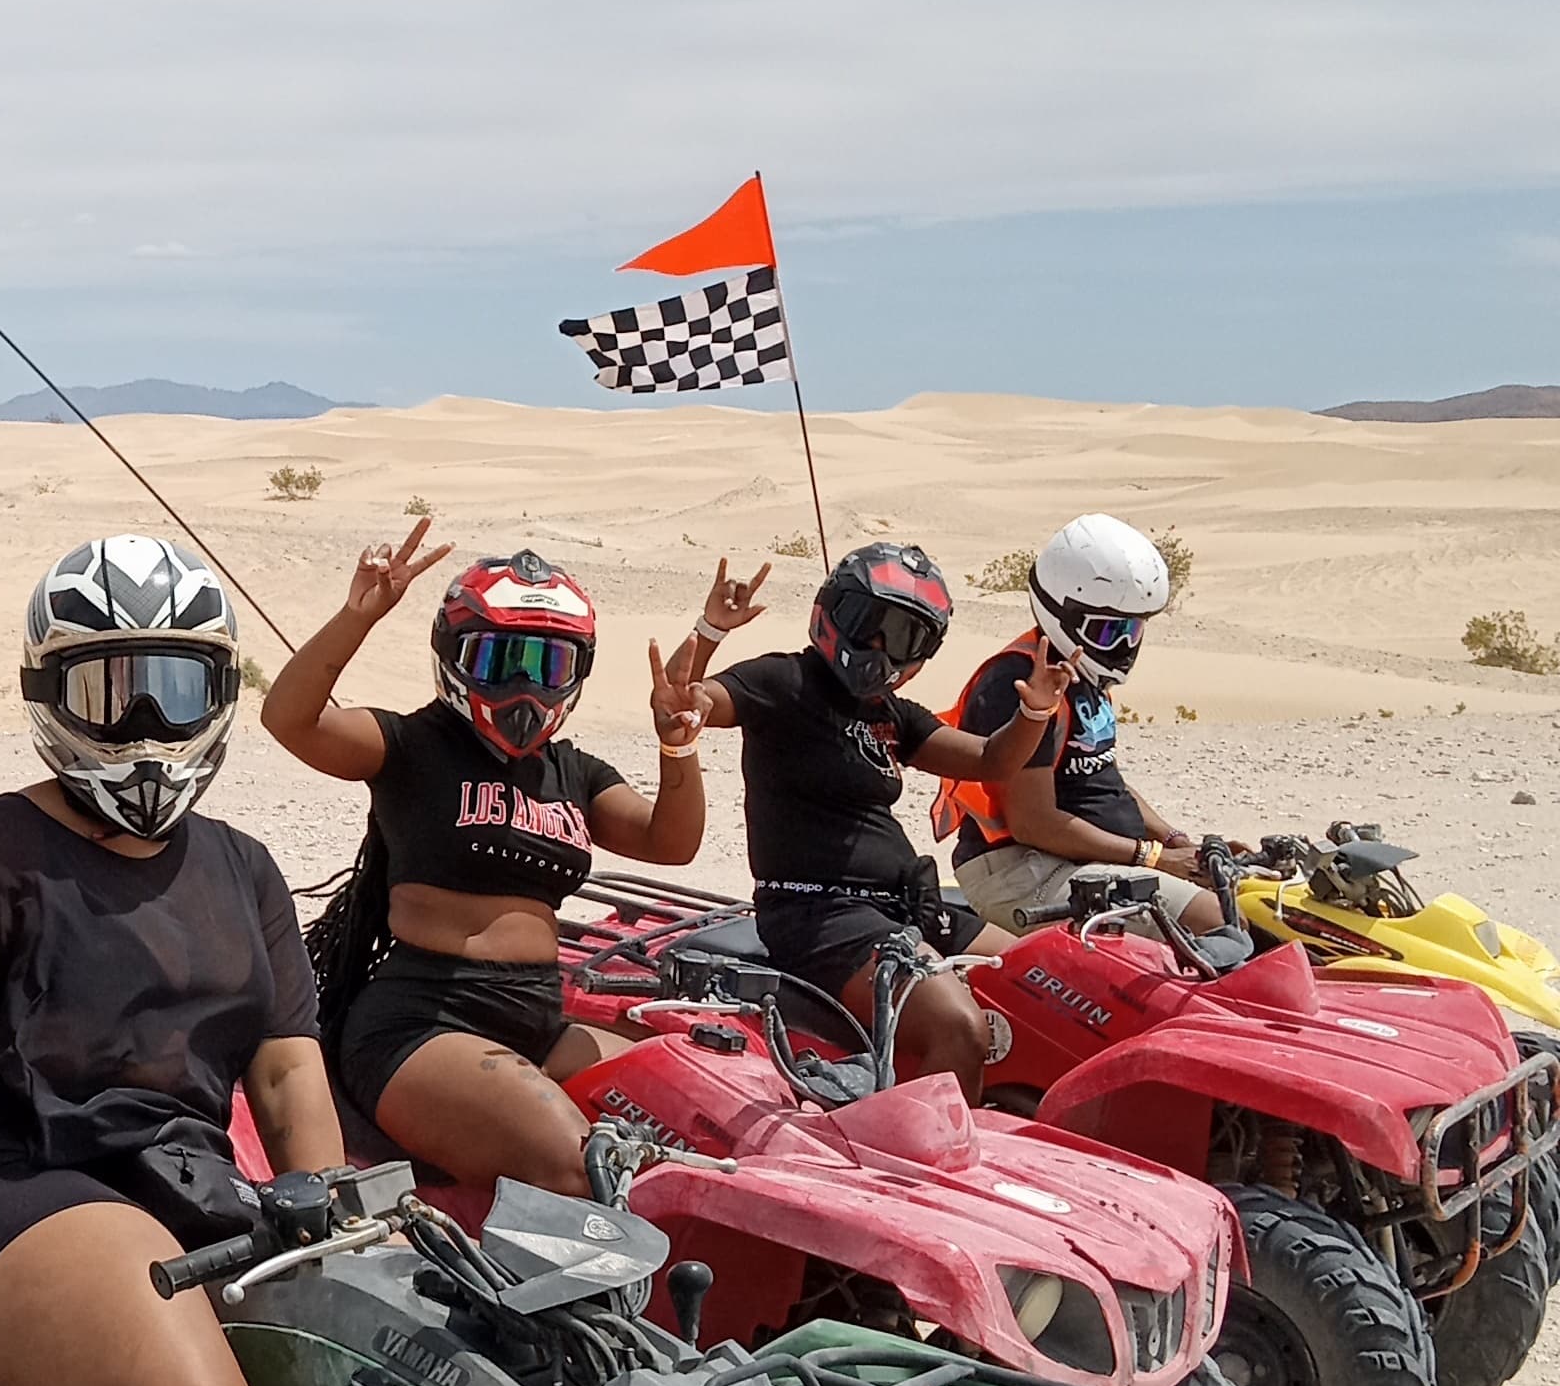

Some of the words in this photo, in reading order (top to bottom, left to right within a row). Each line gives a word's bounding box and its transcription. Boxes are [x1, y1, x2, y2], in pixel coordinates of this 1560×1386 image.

[456, 781, 506, 827] LOS
[471, 842, 588, 880] CALIFORNI
[1024, 966, 1112, 1026] BRUIN
